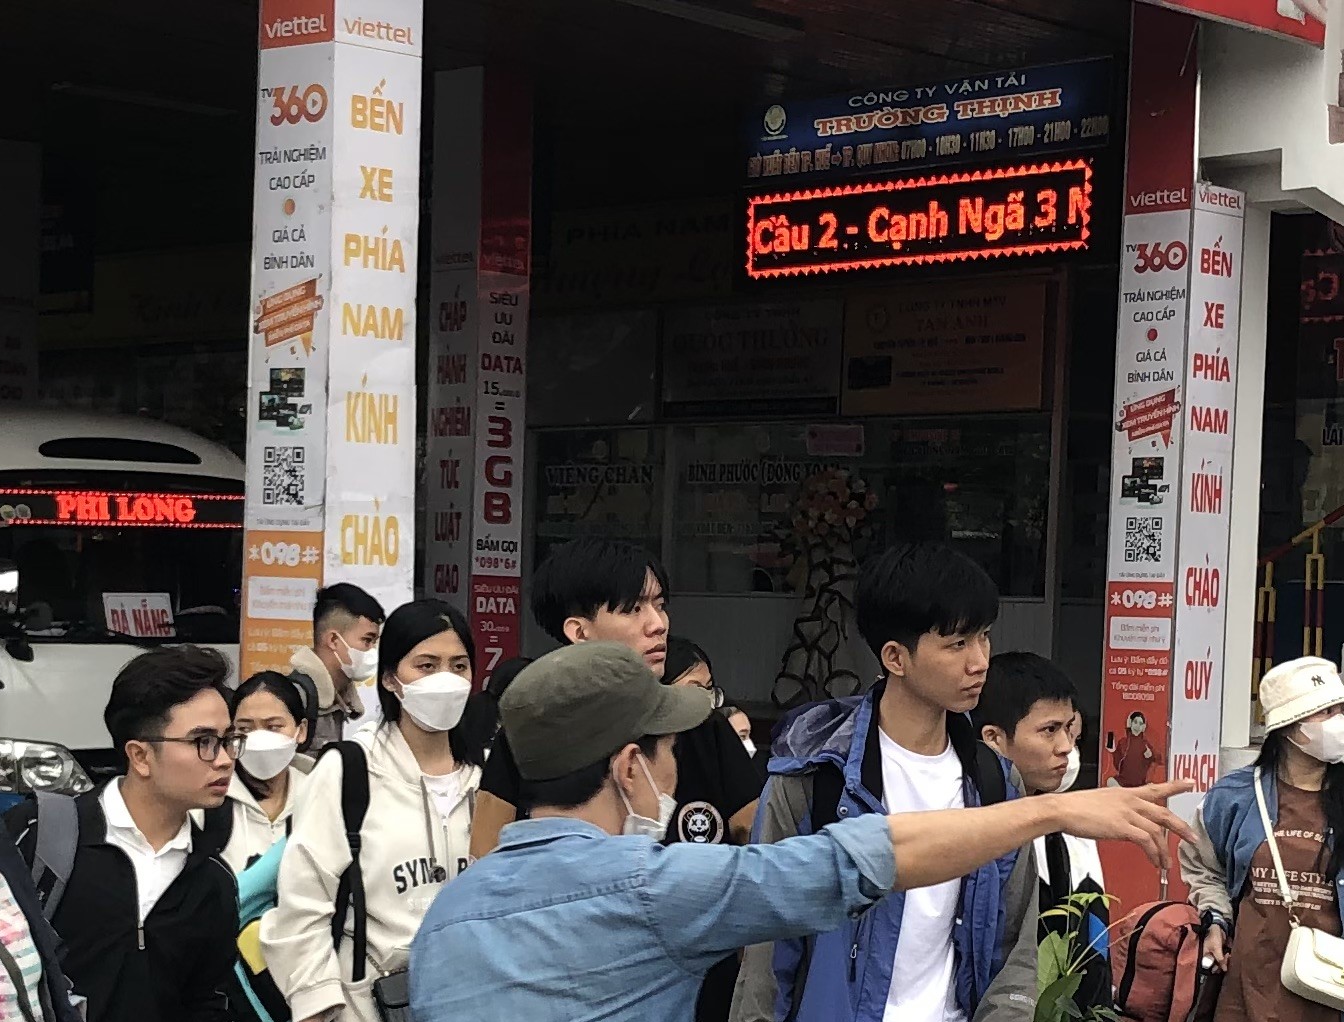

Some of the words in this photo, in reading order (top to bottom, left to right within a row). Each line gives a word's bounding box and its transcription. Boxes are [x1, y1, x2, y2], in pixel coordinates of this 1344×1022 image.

[265, 14, 328, 39] viettel
[343, 17, 414, 46] viettel
[847, 89, 909, 108] CÔNG
[914, 85, 938, 99] TY
[944, 79, 989, 96] VẬN
[995, 71, 1026, 88] TẢI
[350, 79, 404, 136] BẾN
[813, 104, 949, 137] TRƯỜNG
[953, 88, 1063, 120] THỊNH
[269, 175, 291, 191] CAO
[292, 169, 315, 190] CẤP
[358, 165, 394, 203] XE
[1130, 187, 1188, 208] viettel
[1198, 190, 1242, 210] viettel
[754, 214, 809, 254] Cầu
[819, 212, 839, 249] 2
[867, 200, 949, 251] Cạnh
[958, 190, 1026, 242] Ngã
[1034, 188, 1058, 229] 3
[343, 225, 406, 273] PHÍA
[1200, 235, 1233, 279] BẾN
[488, 291, 519, 307] SIÊU
[1123, 288, 1146, 304] TRẢI
[1146, 286, 1186, 303] NGHIỆM
[341, 302, 404, 341] NAM
[1133, 311, 1154, 323] CAO
[1155, 305, 1176, 321] CẤP
[1203, 301, 1225, 330] XE
[480, 353, 523, 375] DATA
[1136, 348, 1152, 363] GIÁ
[1153, 347, 1167, 362] CẢ
[1192, 347, 1231, 383] PHÍA
[346, 371, 399, 445] KÍNH
[1190, 405, 1229, 435] NAM
[487, 415, 513, 449] 3
[484, 455, 513, 488] G
[1190, 458, 1223, 515] KÍNH
[55, 493, 110, 521] PHI
[116, 496, 197, 523] LONG
[483, 491, 513, 525] B
[340, 496, 400, 567] CHÀO
[476, 534, 500, 552] BẤM
[501, 539, 518, 555] GỌI
[434, 564, 460, 594] GIAO
[1185, 552, 1220, 608] CHÀO
[476, 596, 516, 614] DATA
[484, 648, 504, 671] 7
[1184, 645, 1214, 701] QUÝ
[1270, 868, 1299, 882] LFE
